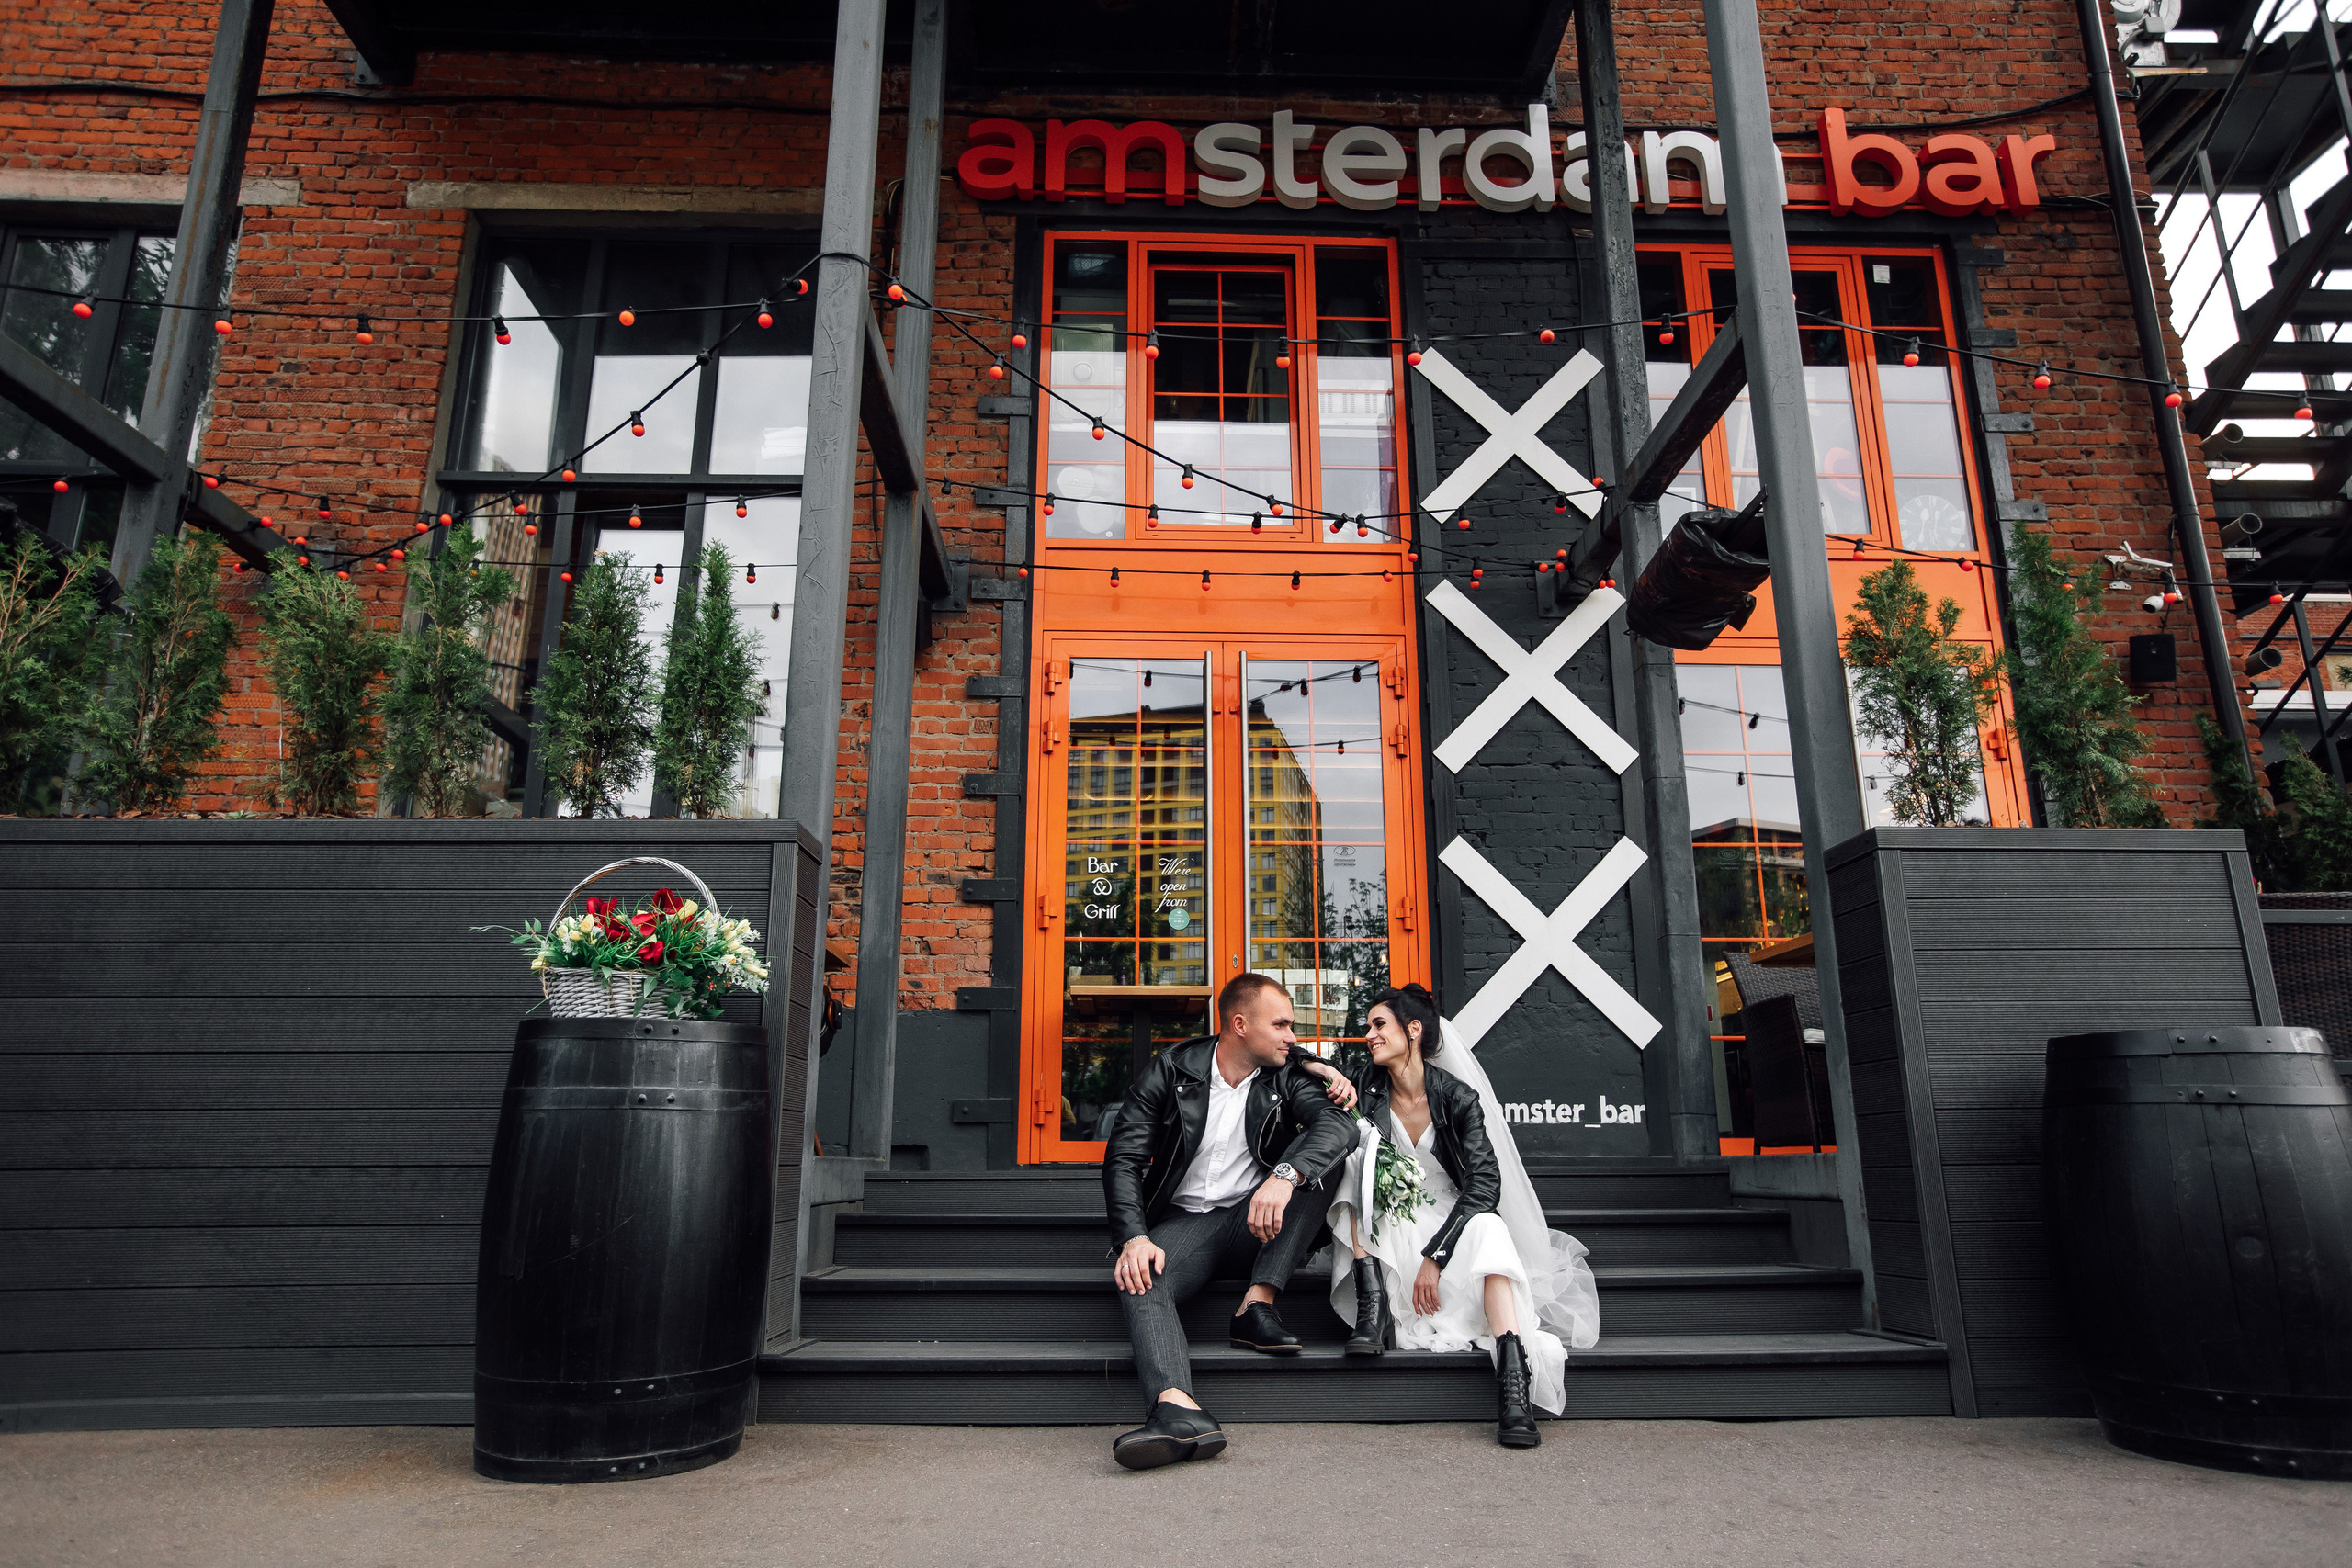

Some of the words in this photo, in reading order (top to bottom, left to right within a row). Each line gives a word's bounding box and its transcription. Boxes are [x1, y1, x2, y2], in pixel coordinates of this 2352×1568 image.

[1817, 107, 2056, 217] bar
[1087, 856, 1118, 874] Bar
[1091, 877, 1112, 896] &
[1160, 882, 1187, 896] open
[1084, 903, 1121, 919] Grill
[1155, 892, 1188, 913] from
[1497, 1095, 1645, 1128] mster_bar
